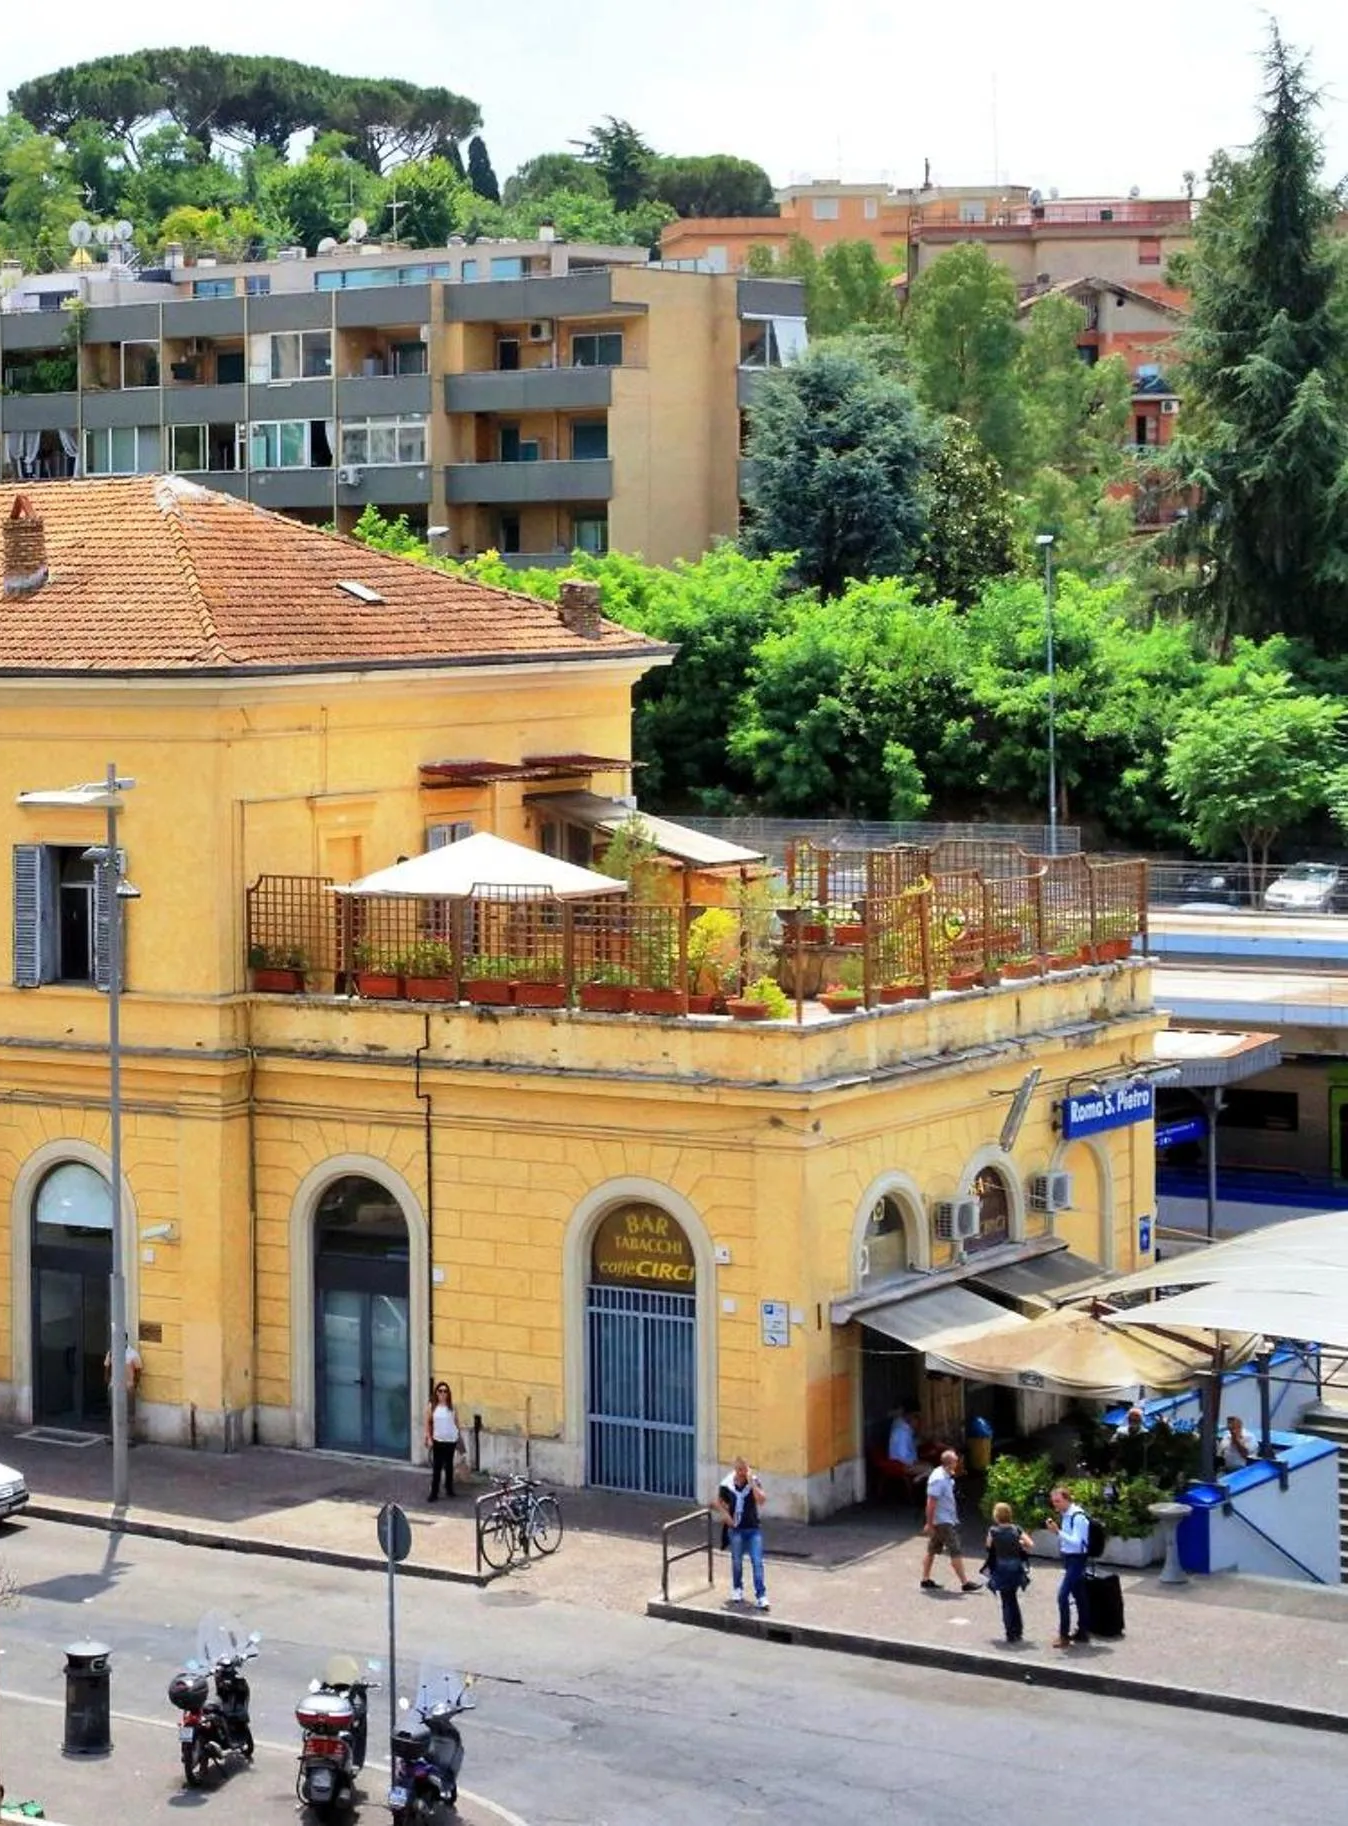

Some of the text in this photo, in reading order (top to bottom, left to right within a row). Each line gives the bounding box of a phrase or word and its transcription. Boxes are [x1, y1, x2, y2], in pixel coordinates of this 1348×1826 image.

[1071, 1101, 1104, 1123] Roma
[1117, 1090, 1150, 1112] Pietro
[626, 1214, 669, 1236] BAR
[615, 1236, 682, 1255] TABACCHI
